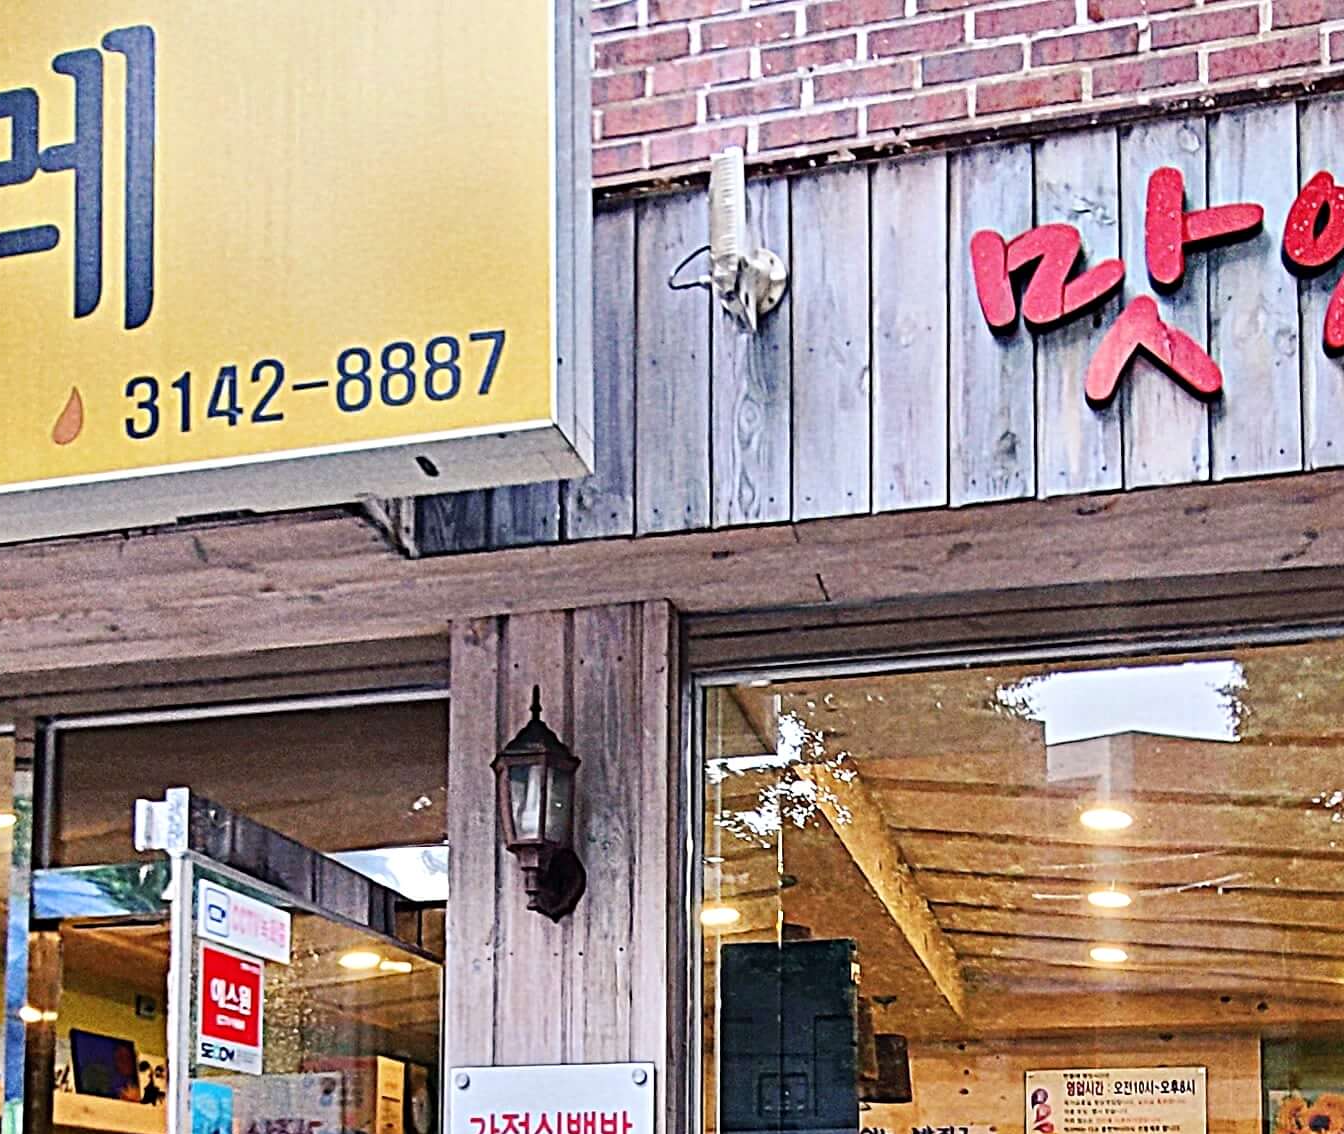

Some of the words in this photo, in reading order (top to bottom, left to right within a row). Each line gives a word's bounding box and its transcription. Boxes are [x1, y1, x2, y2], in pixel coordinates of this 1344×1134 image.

[122, 330, 508, 443] 3142-8887
[209, 977, 253, 1016] 에스원
[1067, 1081, 1104, 1096] 영업시간
